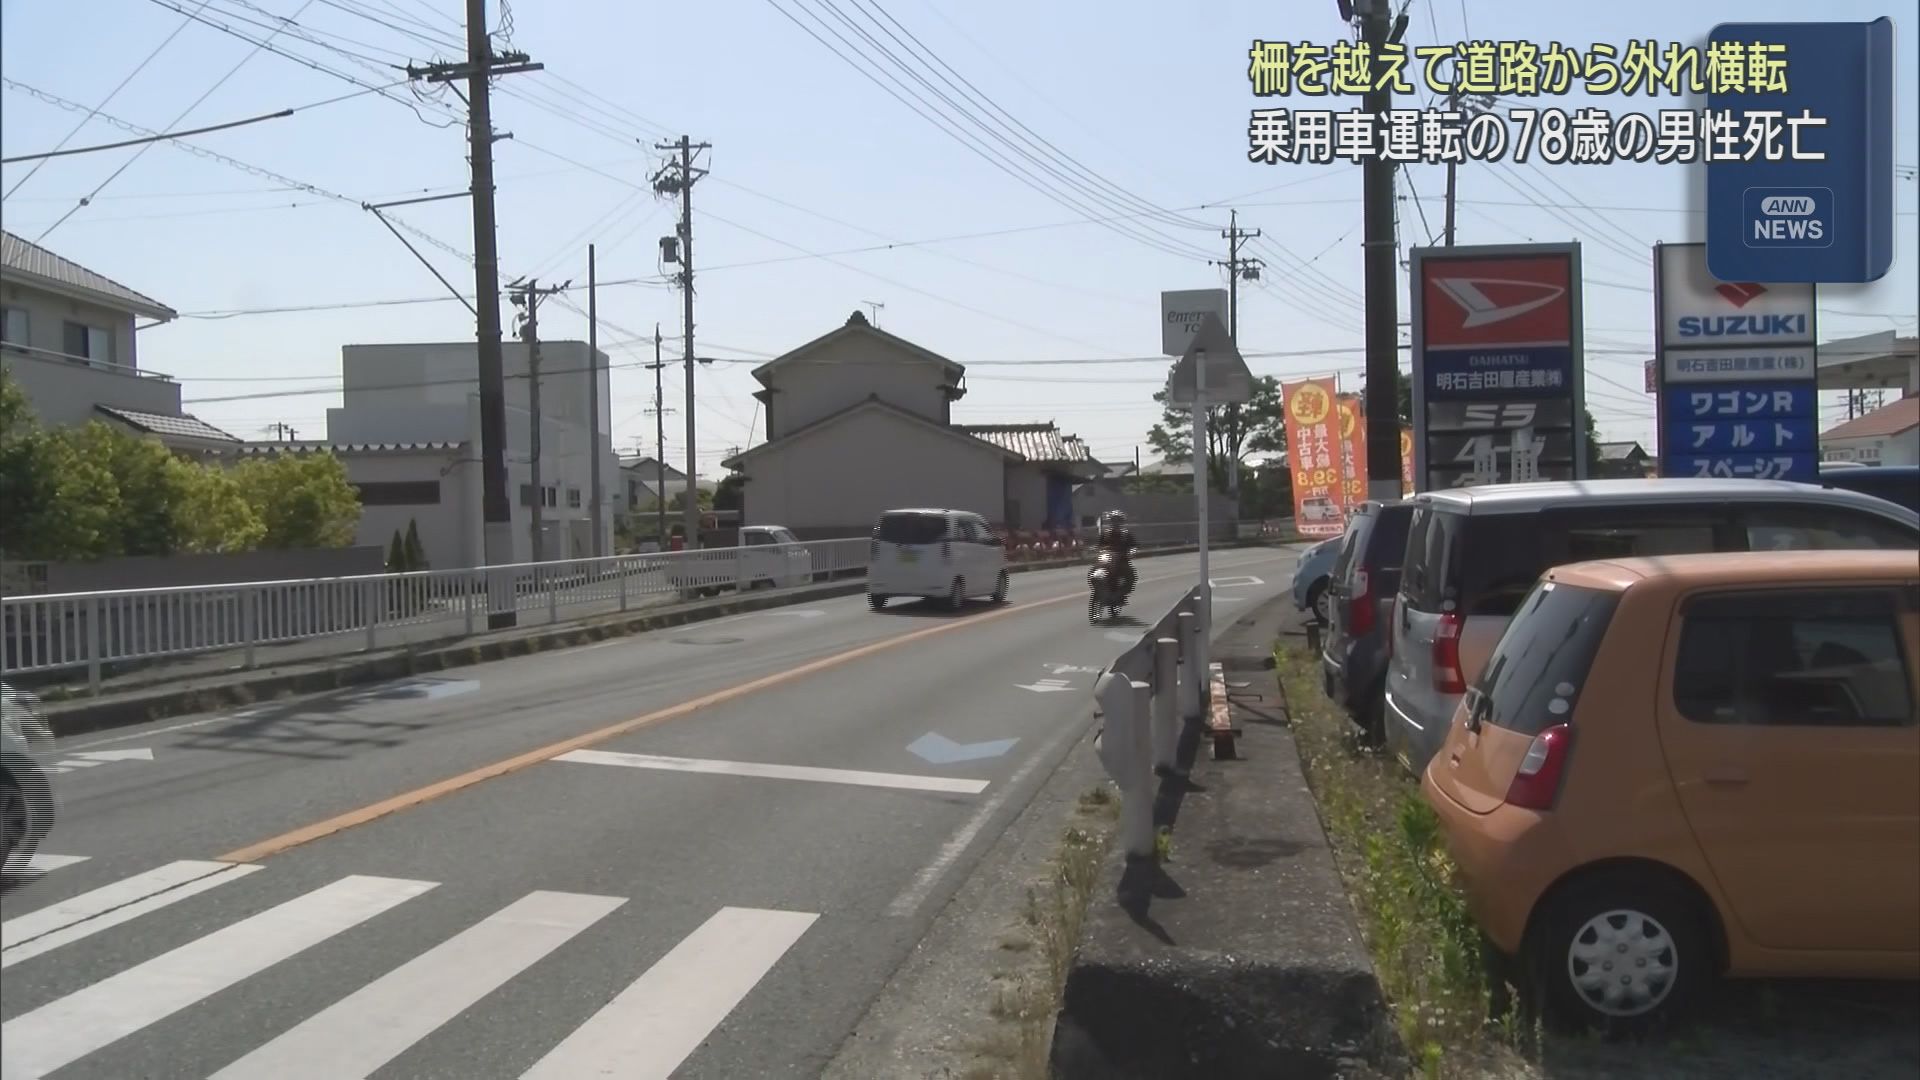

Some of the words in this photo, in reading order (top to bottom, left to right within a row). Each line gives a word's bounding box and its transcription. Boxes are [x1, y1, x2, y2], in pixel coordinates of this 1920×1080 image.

[1678, 314, 1806, 337] SUZUKI
[1469, 354, 1529, 367] DAIHATSU
[1461, 403, 1537, 427] ミラ
[1691, 391, 1793, 416] ワゴンR
[1692, 423, 1793, 448] アルト
[1693, 457, 1793, 479] スペーシア
